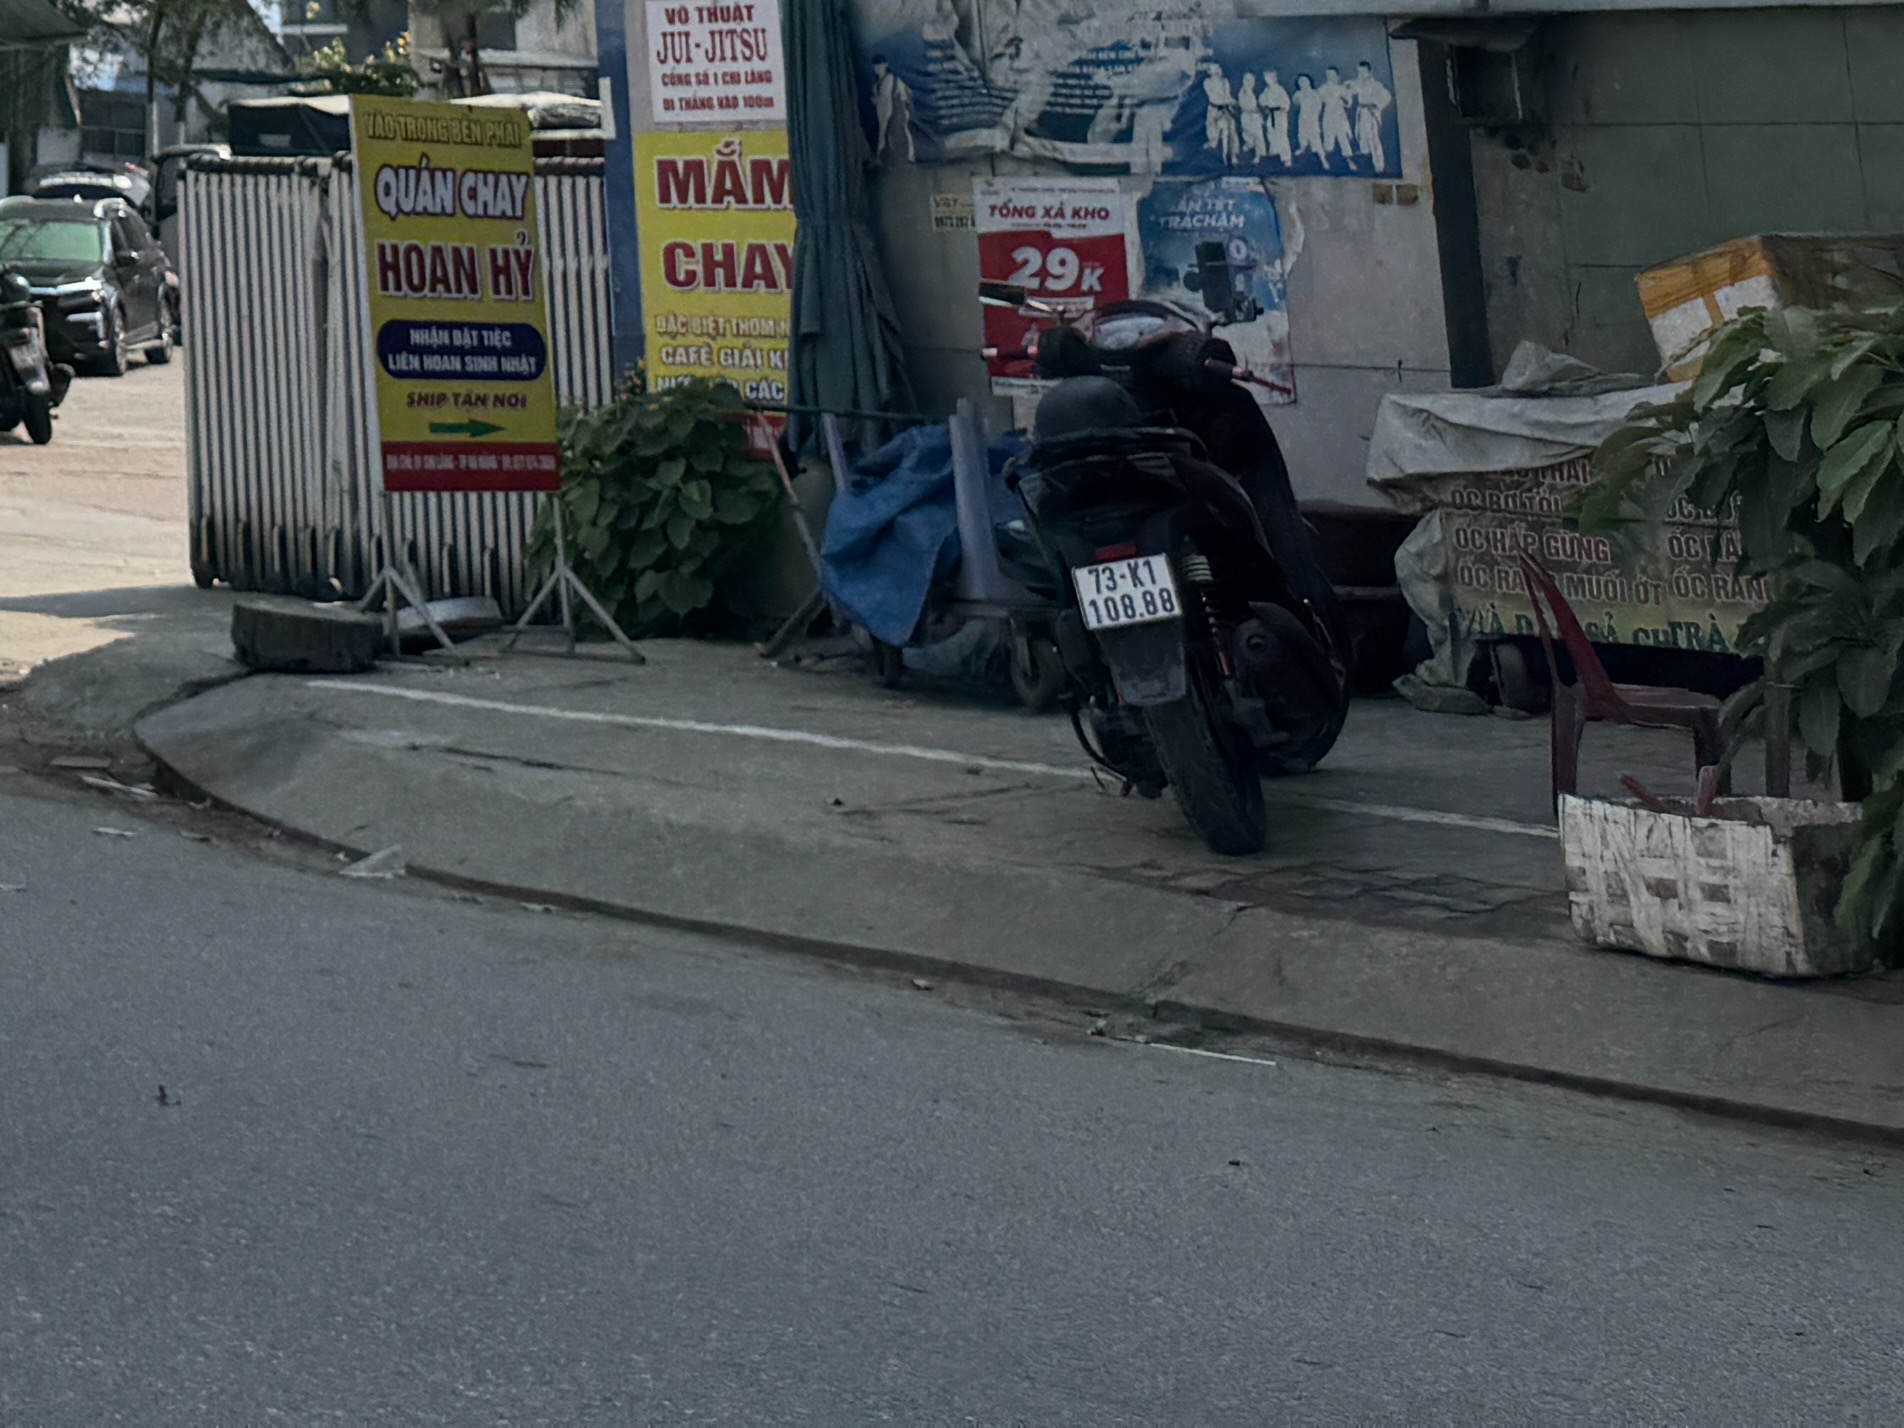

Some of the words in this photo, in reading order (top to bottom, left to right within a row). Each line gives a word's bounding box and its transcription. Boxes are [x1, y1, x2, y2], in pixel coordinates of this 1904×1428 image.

[374, 152, 456, 221] QUÁN
[459, 169, 530, 220] CHAY
[988, 197, 1036, 219] TỔNG
[1071, 206, 1111, 221] KHO
[376, 241, 482, 300] HOAN
[406, 391, 449, 409] SHIP
[1087, 558, 1157, 595] 73-K1
[1088, 587, 1176, 625] 108.88
